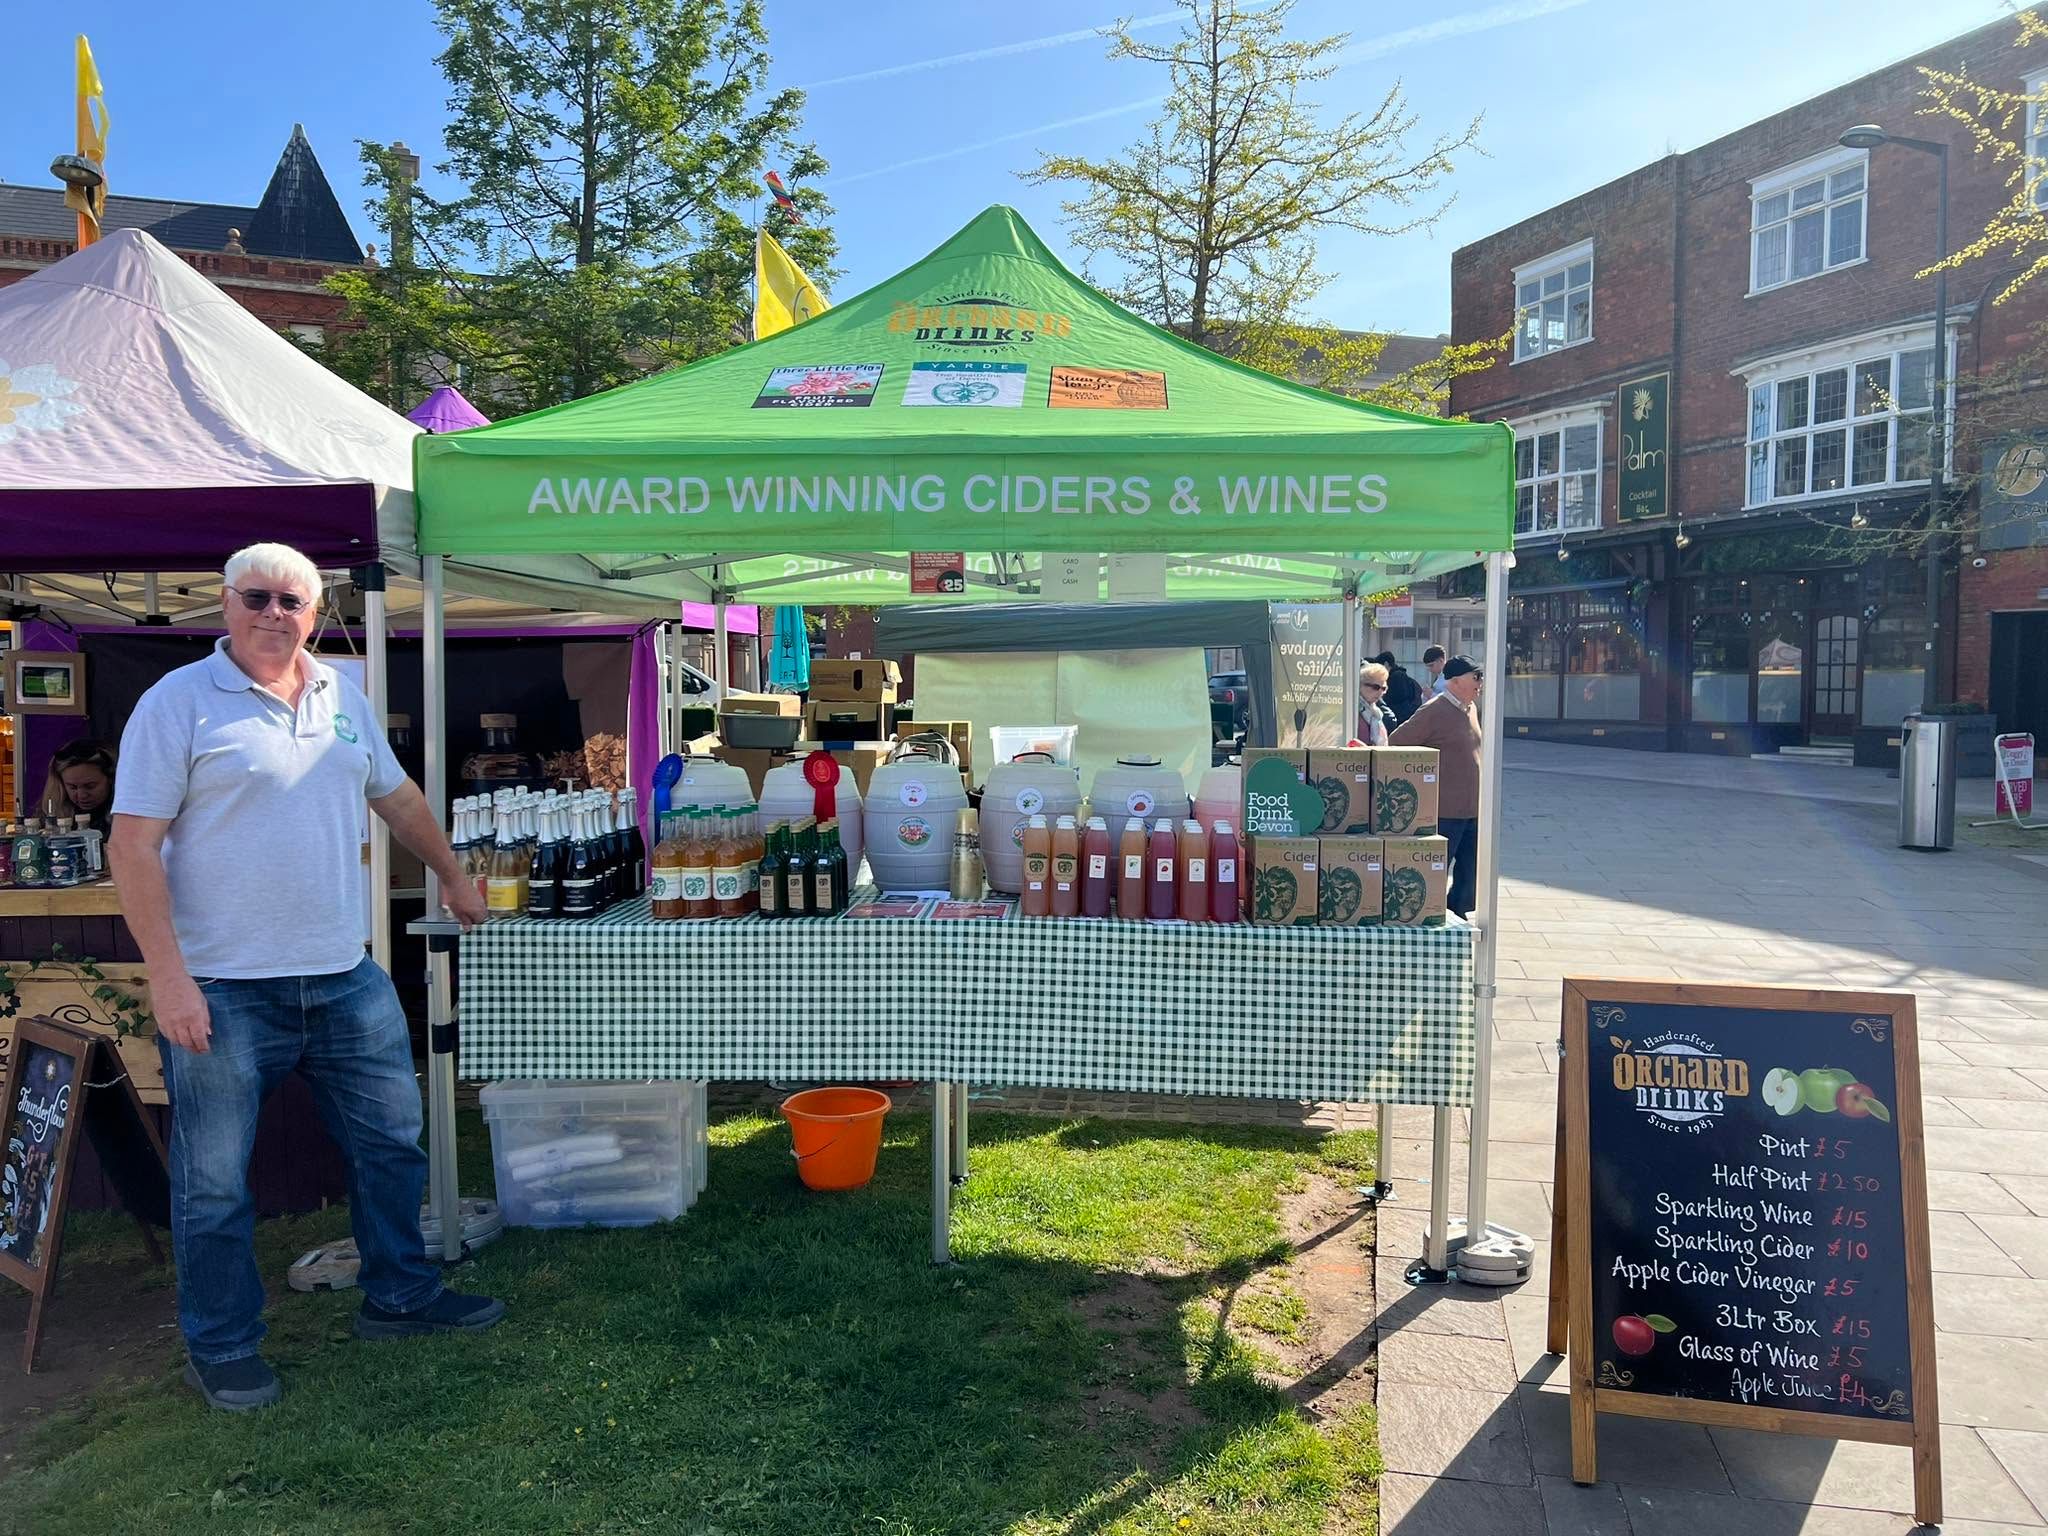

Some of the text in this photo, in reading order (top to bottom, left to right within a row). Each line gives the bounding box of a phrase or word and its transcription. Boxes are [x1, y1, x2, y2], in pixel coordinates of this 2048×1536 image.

[775, 366, 811, 374] Three
[855, 364, 881, 372] Pigs
[1622, 430, 1665, 473] Palm
[528, 473, 1388, 516] AWARD WINNING CIDERS & WINES
[1628, 488, 1657, 501] Cocktail
[1336, 762, 1368, 773] Cider
[1404, 763, 1436, 774] Cider
[1248, 792, 1289, 807] Food
[1248, 807, 1293, 821] Drink
[1247, 820, 1293, 833] Devon
[1283, 852, 1316, 862] Cider
[1347, 852, 1381, 862] Cider
[1412, 852, 1445, 862] Cider
[1643, 1031, 1715, 1052] Handcrafted
[1648, 1115, 1714, 1134] Since 1983
[1759, 1133, 1810, 1158] Pint
[1712, 1163, 1758, 1190] Half
[1760, 1167, 1812, 1191] Pint
[1655, 1192, 1868, 1232] Sparkling Wine £15
[1654, 1226, 1868, 1266] Sparkling Cider £10
[1611, 1255, 1861, 1304] Apple Cider Vinegar £5
[1716, 1304, 1872, 1338] 3Ltr Box £15
[1679, 1335, 1733, 1362] Glass
[1740, 1341, 1763, 1367] of
[1765, 1343, 1820, 1371] Wine
[1731, 1367, 1779, 1403] Apple
[1839, 1374, 1872, 1406] £4
